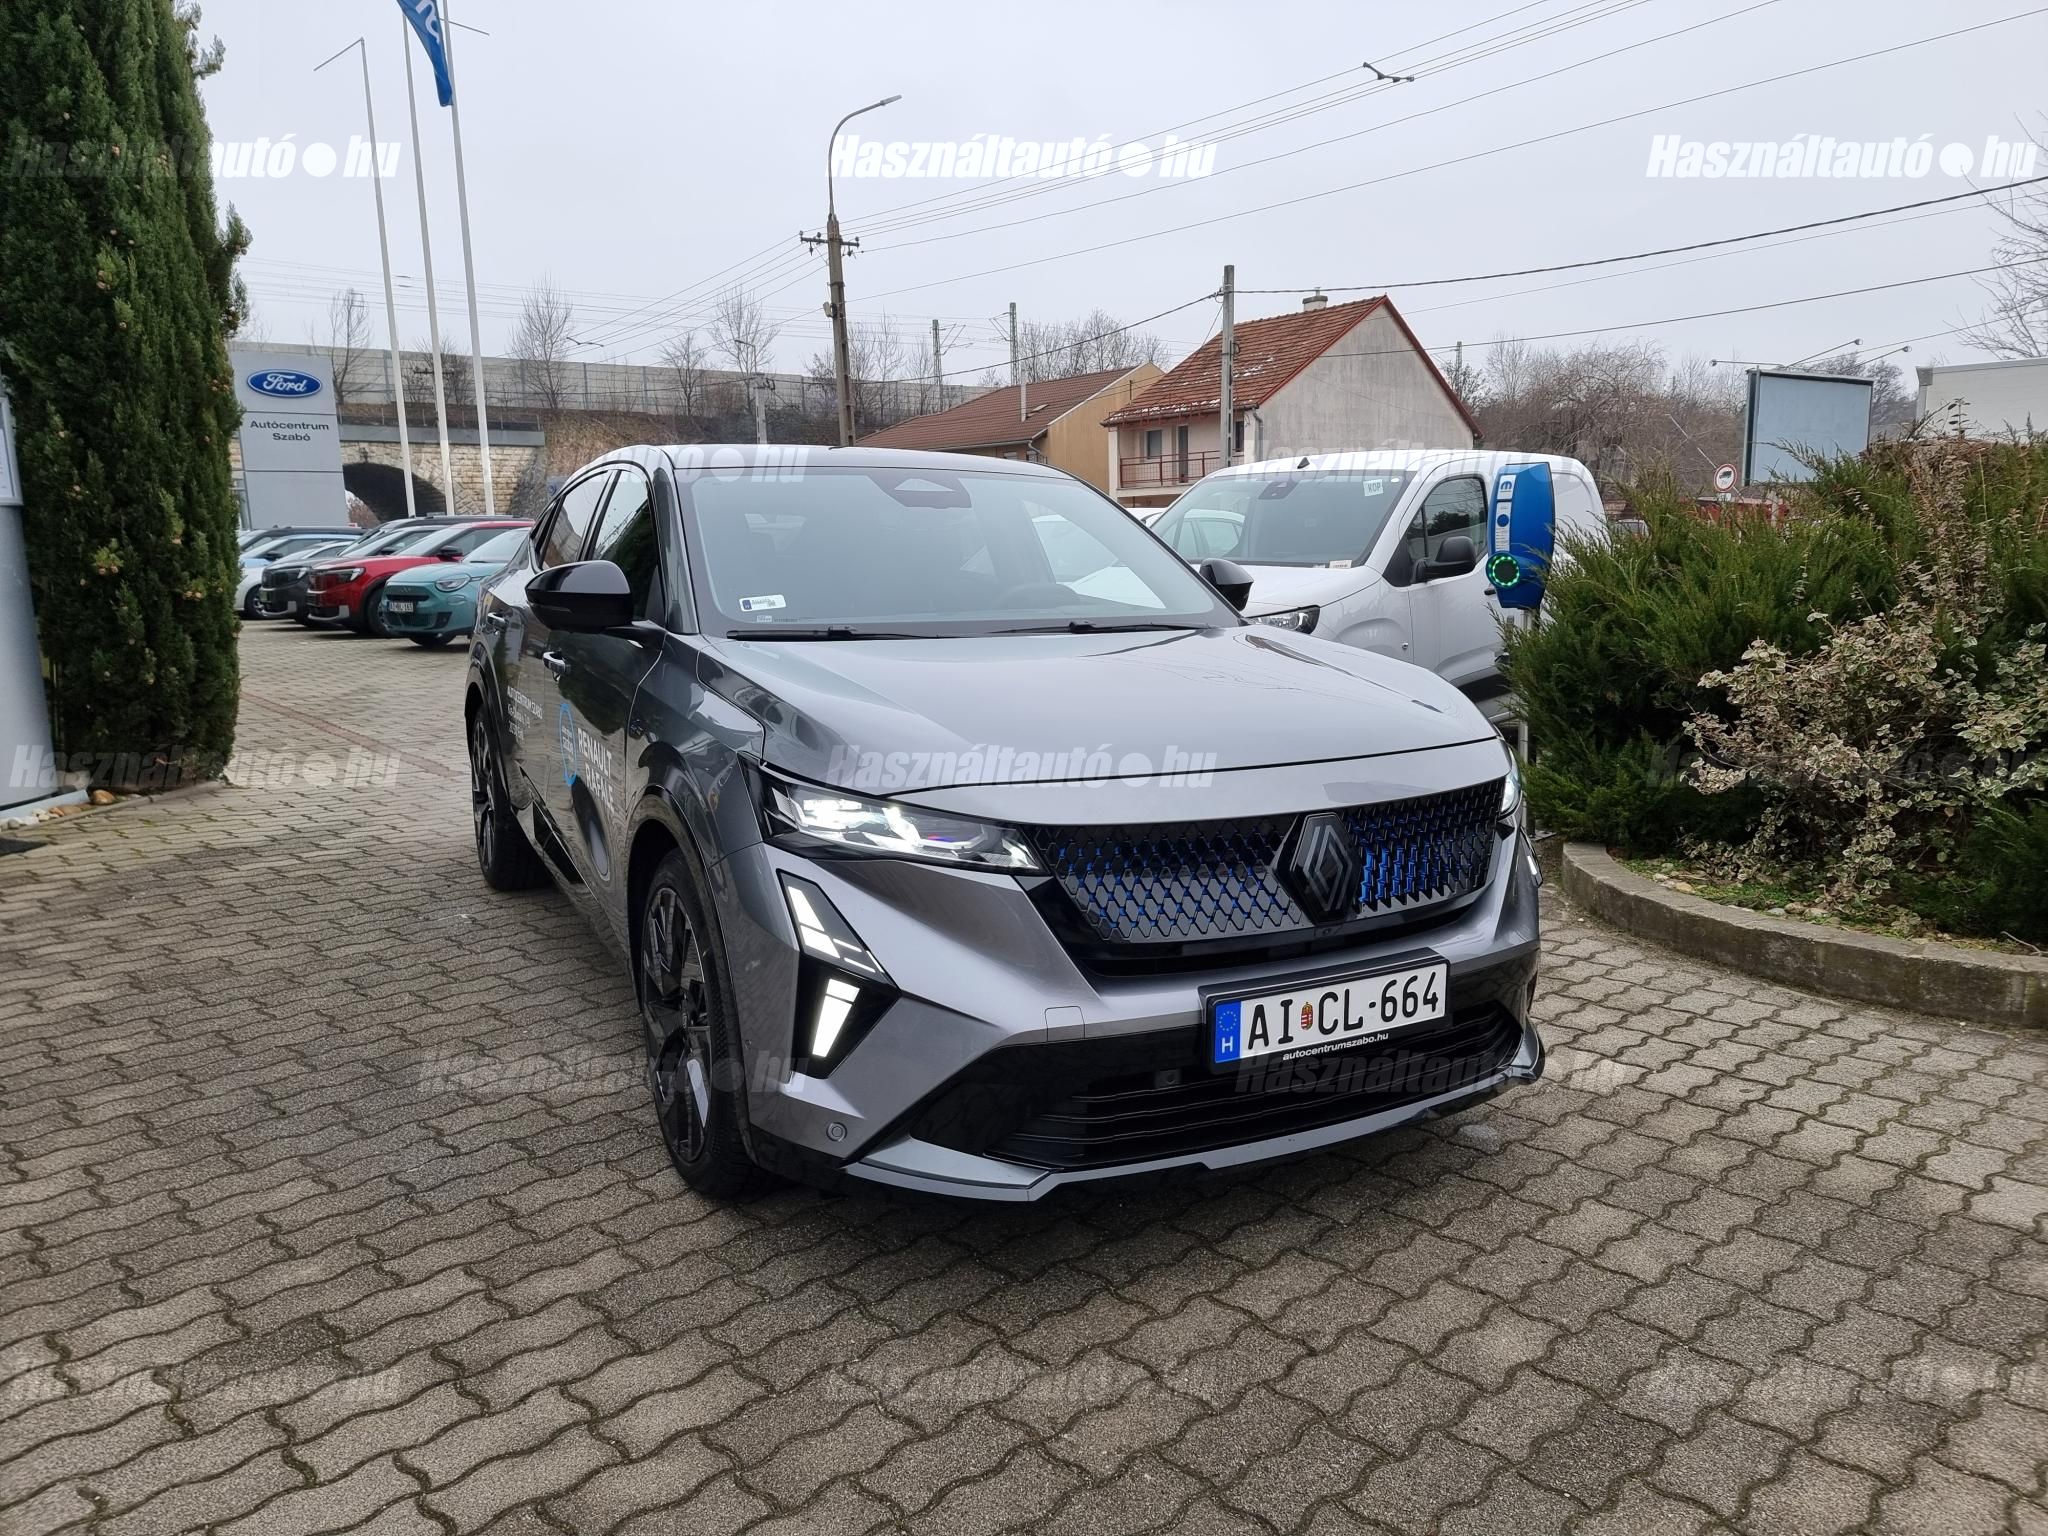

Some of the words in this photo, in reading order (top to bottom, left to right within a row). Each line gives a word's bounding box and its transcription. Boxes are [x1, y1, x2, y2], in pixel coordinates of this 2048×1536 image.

[263, 373, 307, 392] Ford
[272, 432, 311, 442] Szabó
[577, 727, 612, 780] RENAULT
[584, 761, 614, 814] RAFALE
[1247, 999, 1294, 1050] AI
[1317, 971, 1439, 1036] CL-664
[1221, 1036, 1234, 1054] H
[1282, 1032, 1389, 1061] autocentrumszabo.hu
